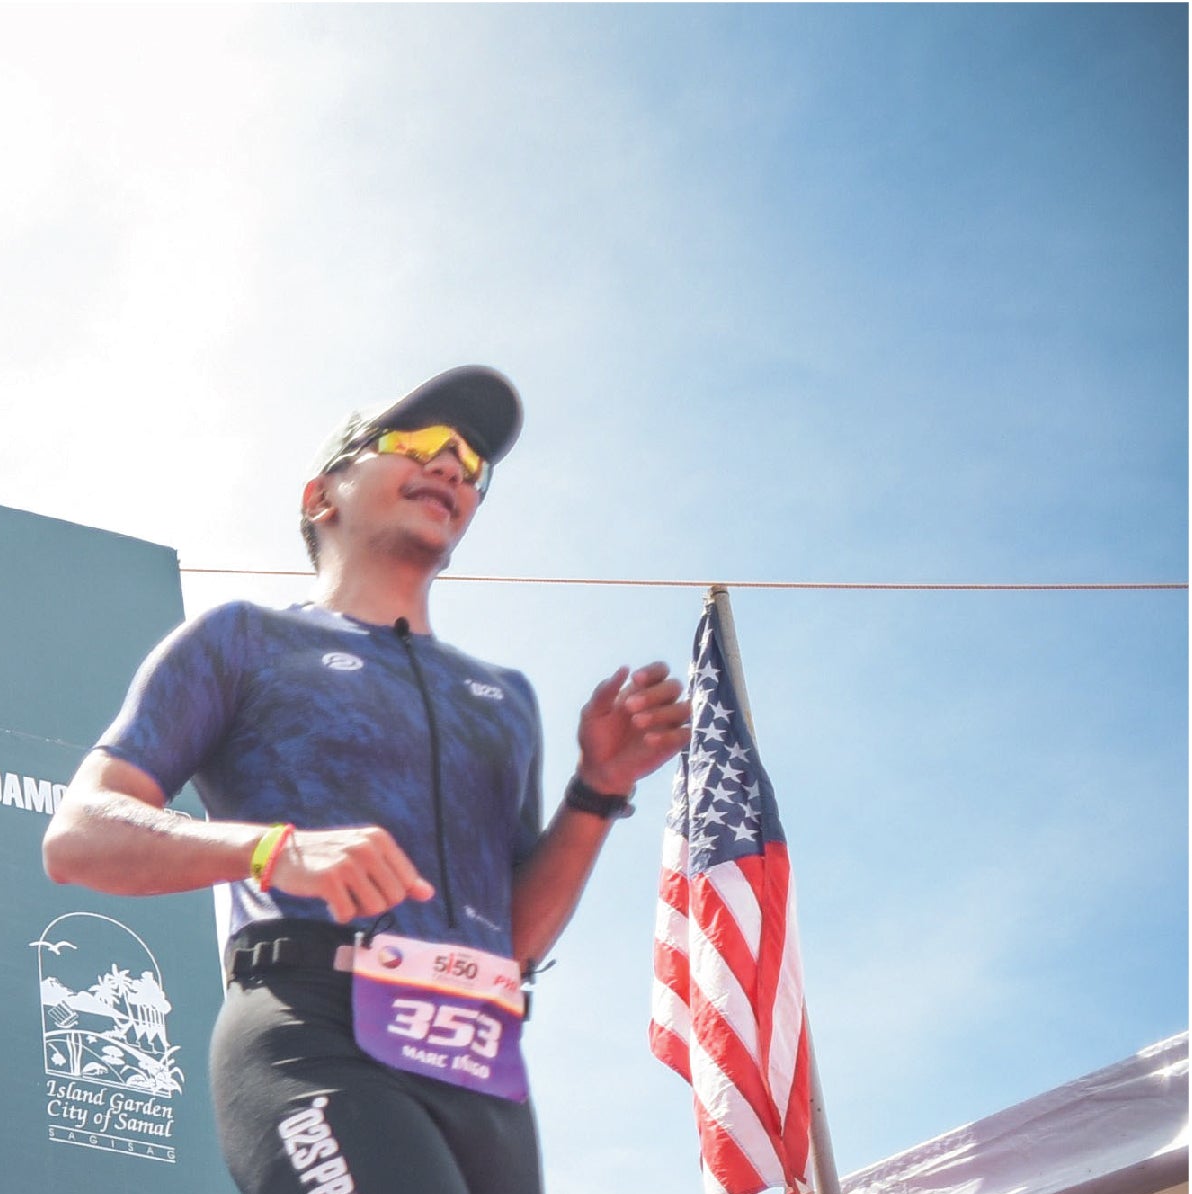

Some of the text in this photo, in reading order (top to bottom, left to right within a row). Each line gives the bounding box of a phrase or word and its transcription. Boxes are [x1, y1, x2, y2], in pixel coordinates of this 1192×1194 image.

[387, 999, 503, 1059] 353
[402, 1045, 449, 1069] MARC
[46, 1080, 174, 1119] Island Garden
[47, 1100, 174, 1138] City of Samal
[47, 1127, 176, 1160] SAGISAG
